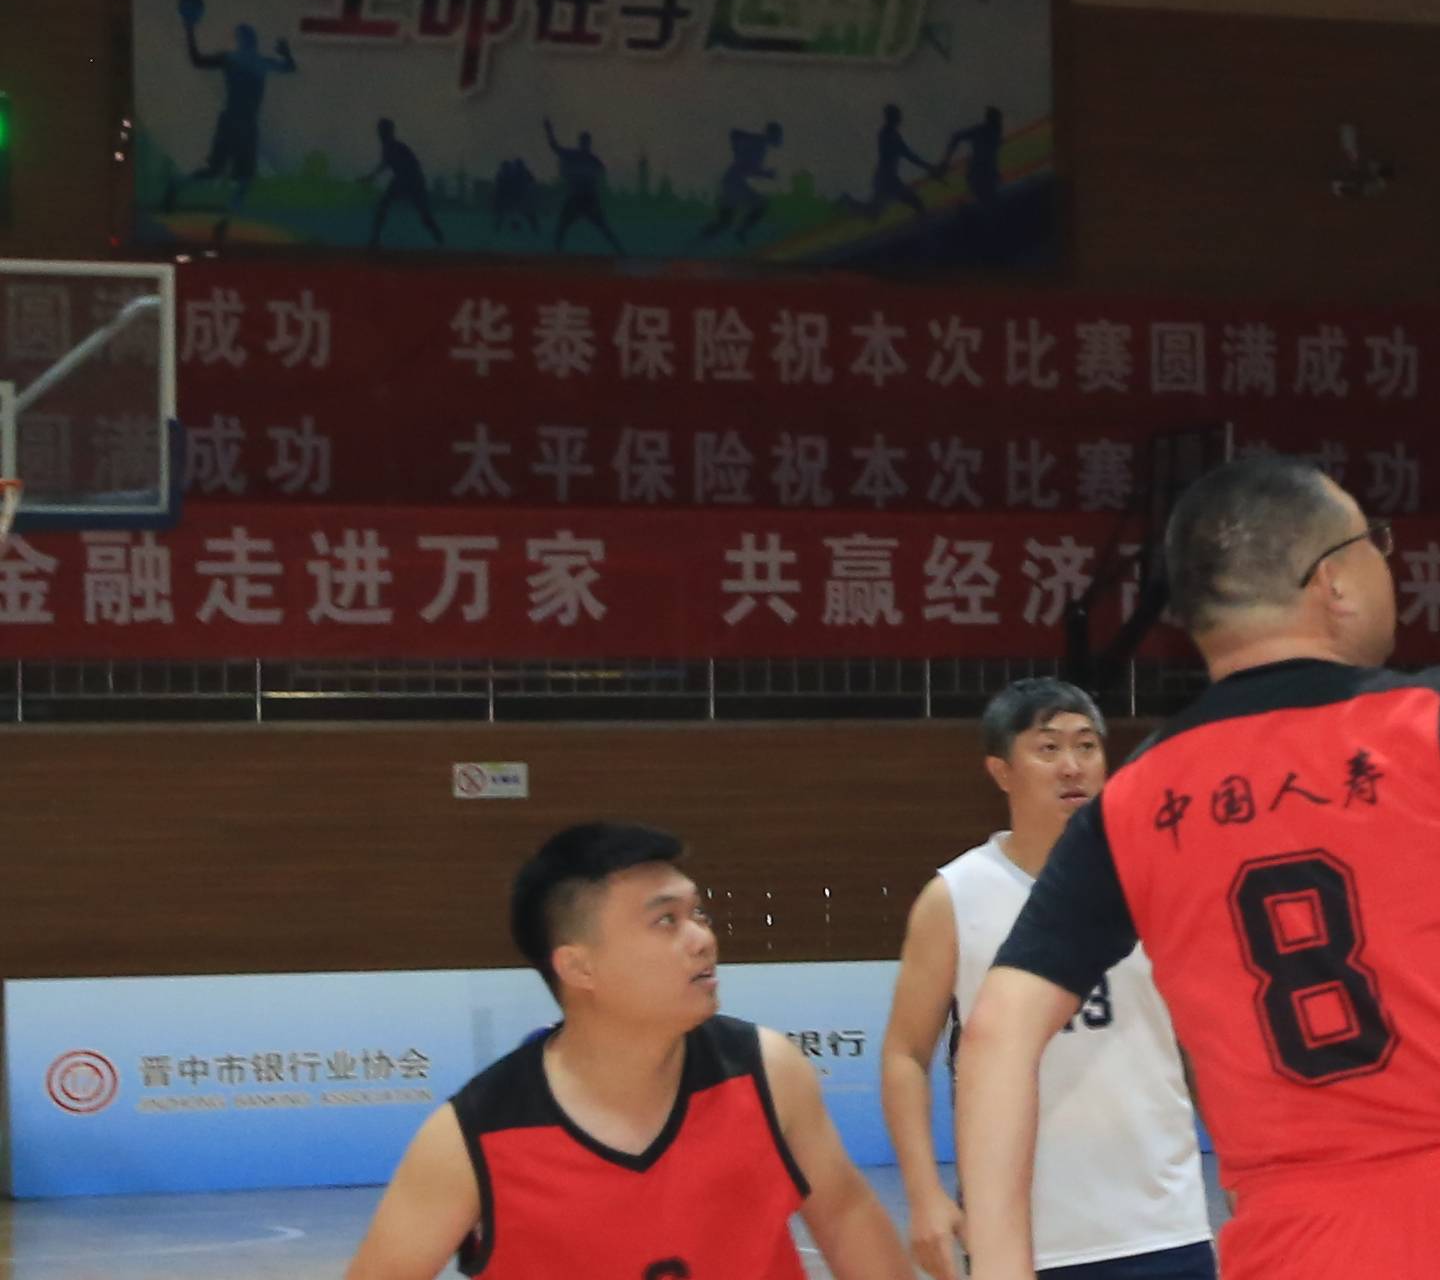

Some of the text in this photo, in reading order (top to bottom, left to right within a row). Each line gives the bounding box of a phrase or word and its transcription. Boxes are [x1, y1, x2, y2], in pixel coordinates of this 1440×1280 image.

[450, 296, 1422, 401] 华泰保险祝本次比赛圆满成功
[1154, 753, 1387, 848] 中国人寿
[1228, 847, 1398, 1086] 8
[140, 1047, 431, 1088] 晋中市银行业协会
